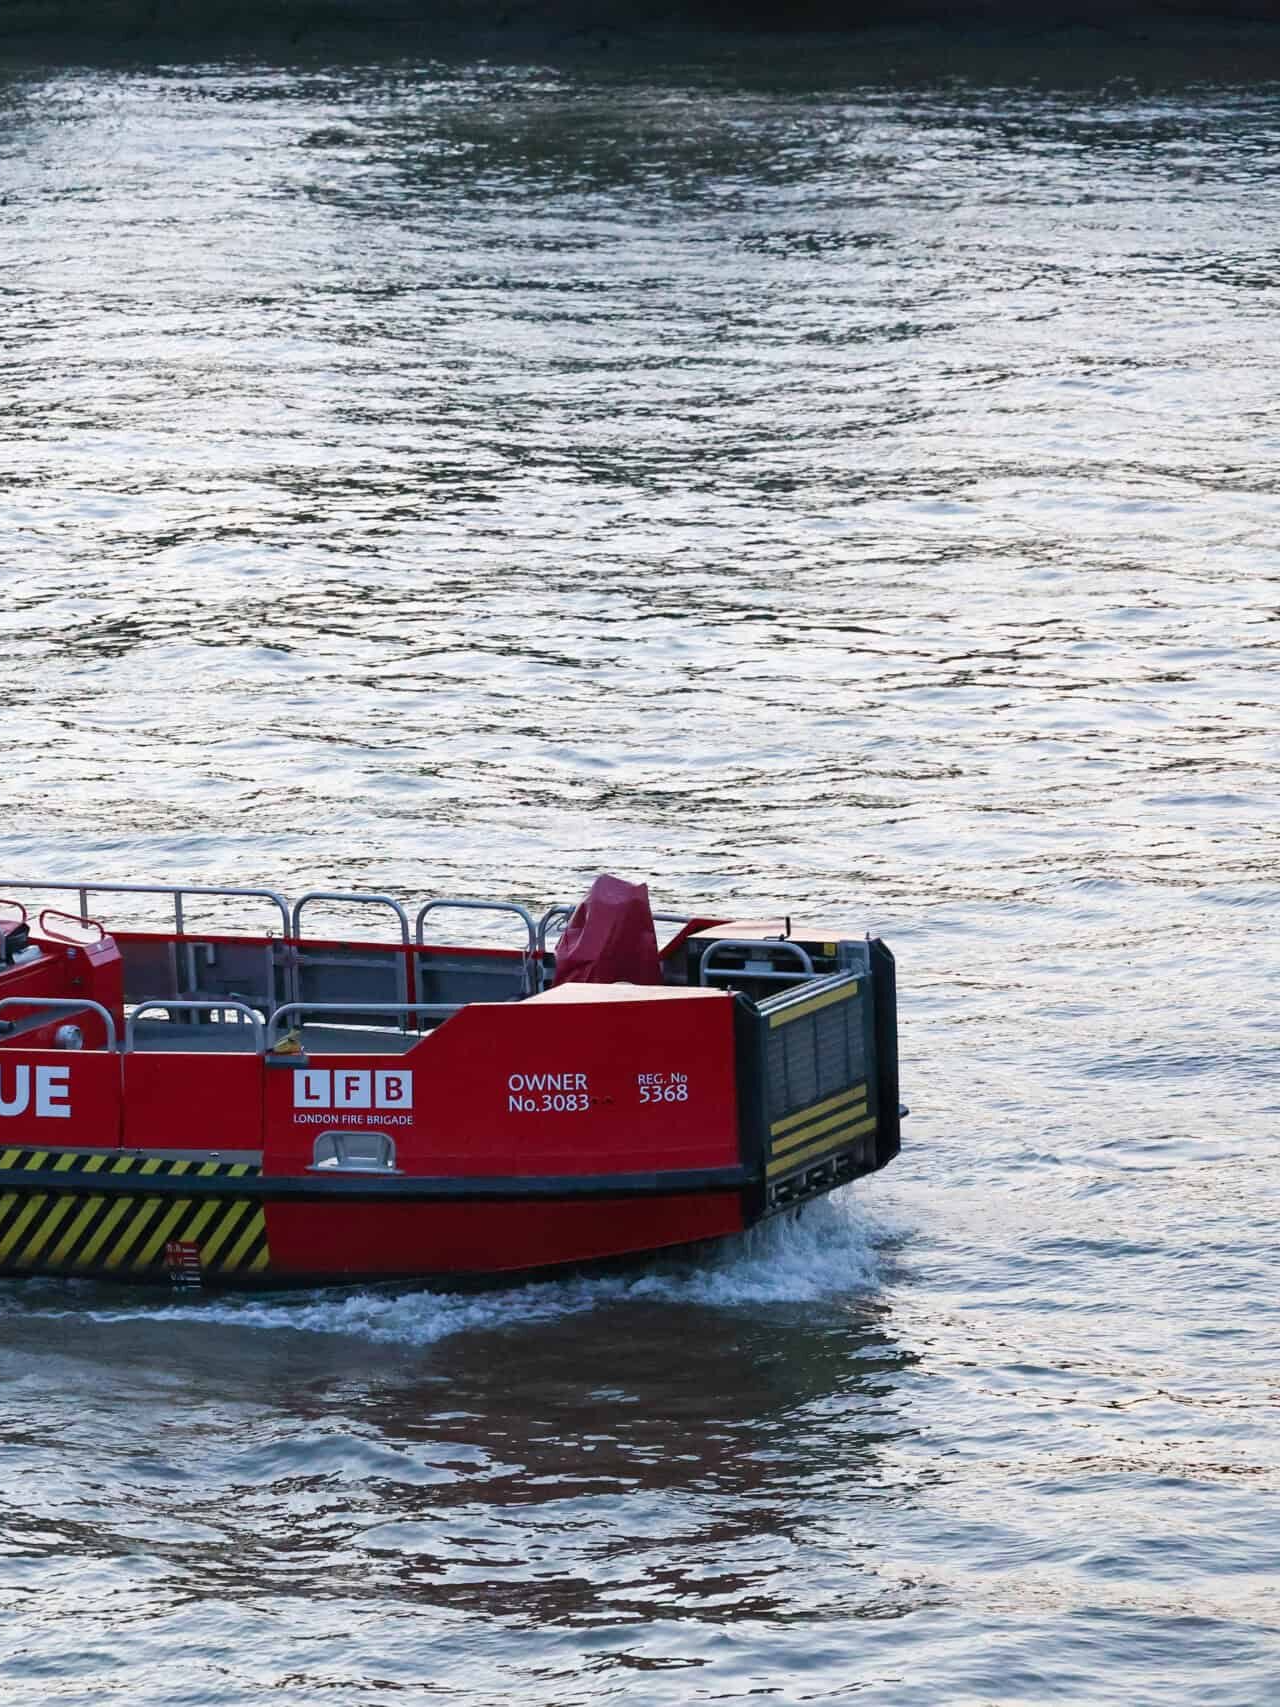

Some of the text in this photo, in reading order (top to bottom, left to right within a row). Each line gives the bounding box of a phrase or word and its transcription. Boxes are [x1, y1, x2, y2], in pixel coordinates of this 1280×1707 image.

[508, 1073, 588, 1092] OWNER
[637, 1072, 689, 1085] REG. No
[303, 1074, 406, 1103] LFB
[639, 1085, 689, 1103] 5368
[508, 1094, 590, 1112] No.3083
[293, 1114, 414, 1126] LONDON FIRE BRIGADE
